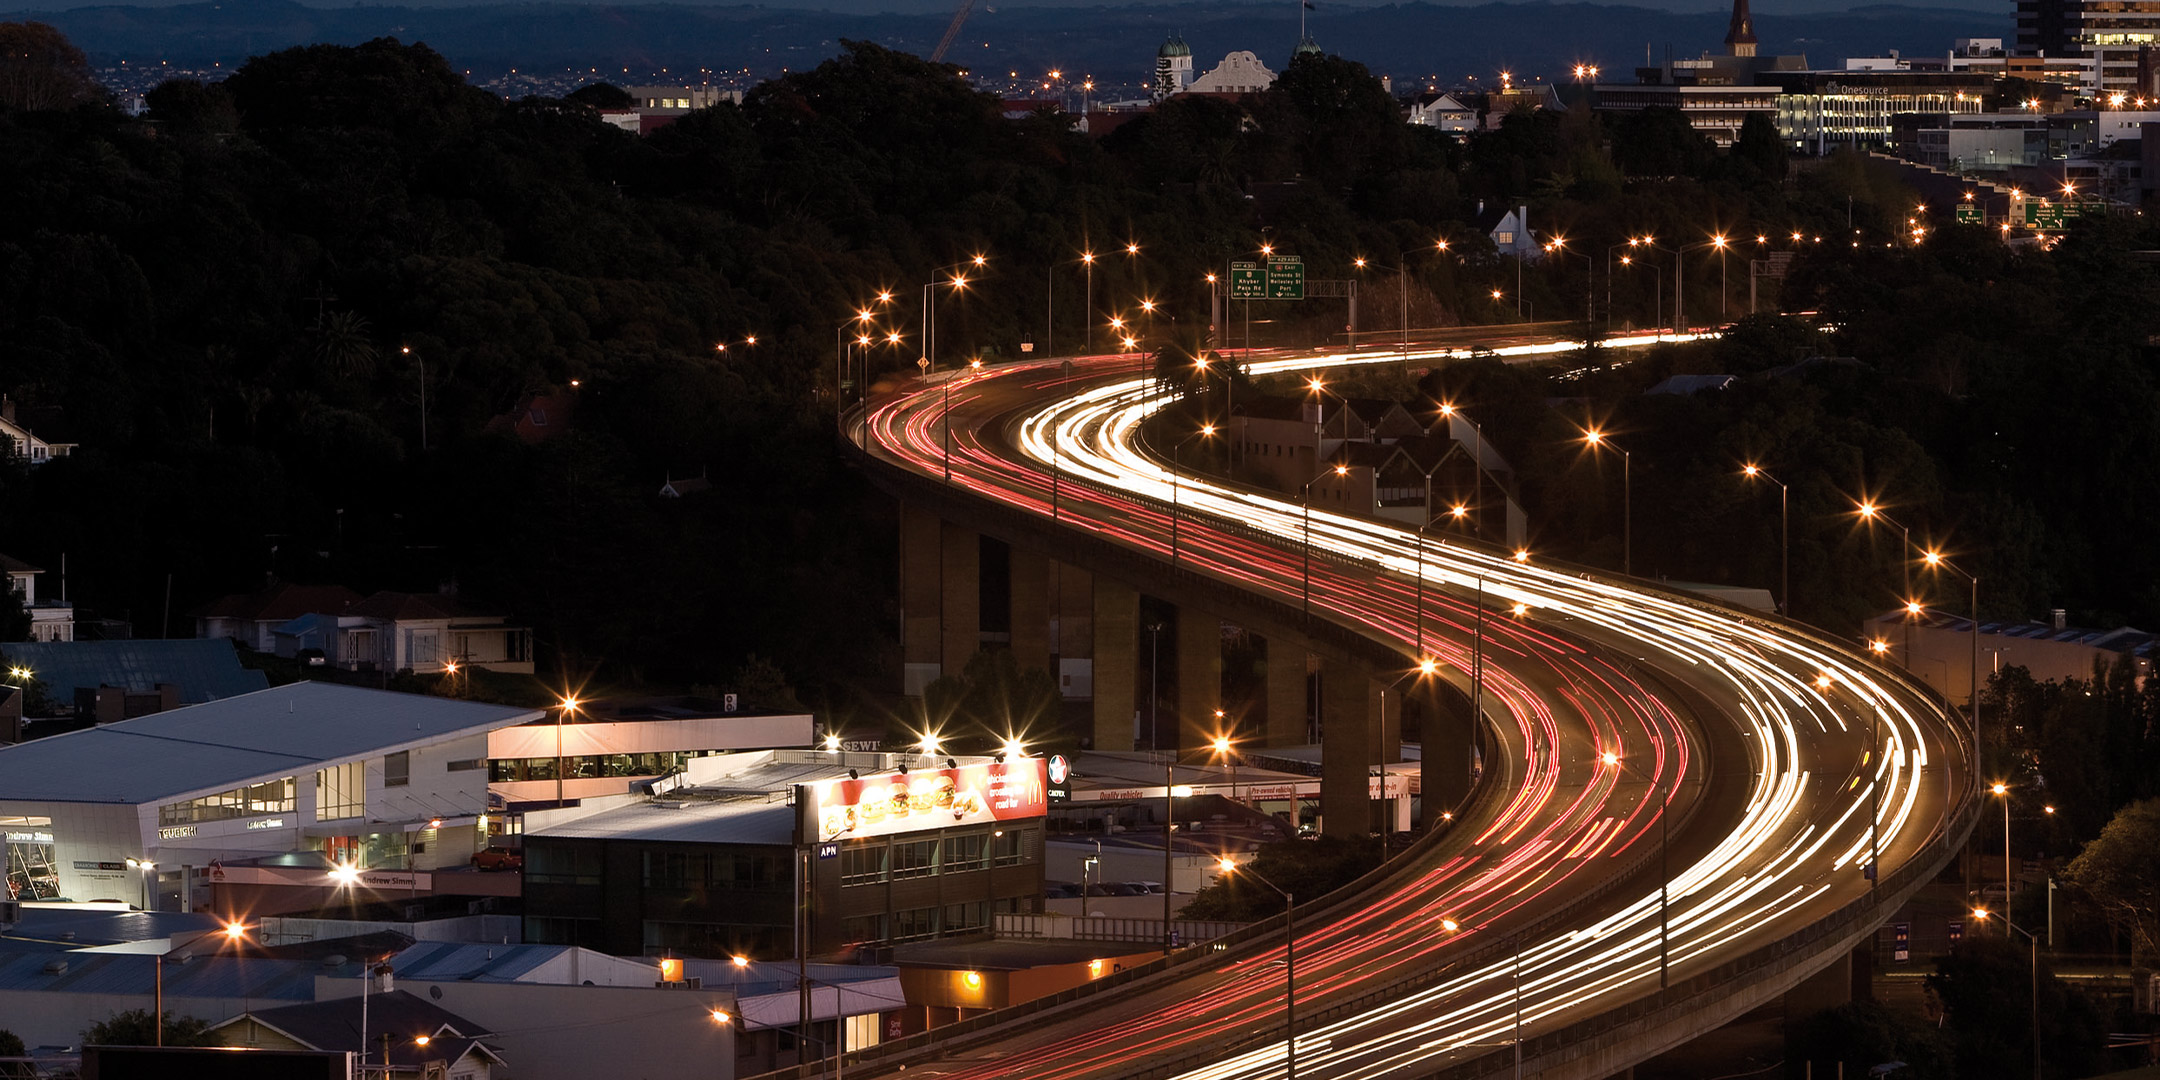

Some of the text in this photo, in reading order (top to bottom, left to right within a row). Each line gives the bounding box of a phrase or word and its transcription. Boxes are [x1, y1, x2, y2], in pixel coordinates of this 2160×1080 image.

[1841, 85, 1889, 95] Onesource
[843, 741, 881, 752] SEWI
[1099, 790, 1143, 800] Quality vehicles
[820, 845, 837, 857] APN
[361, 876, 391, 885] Andrew
